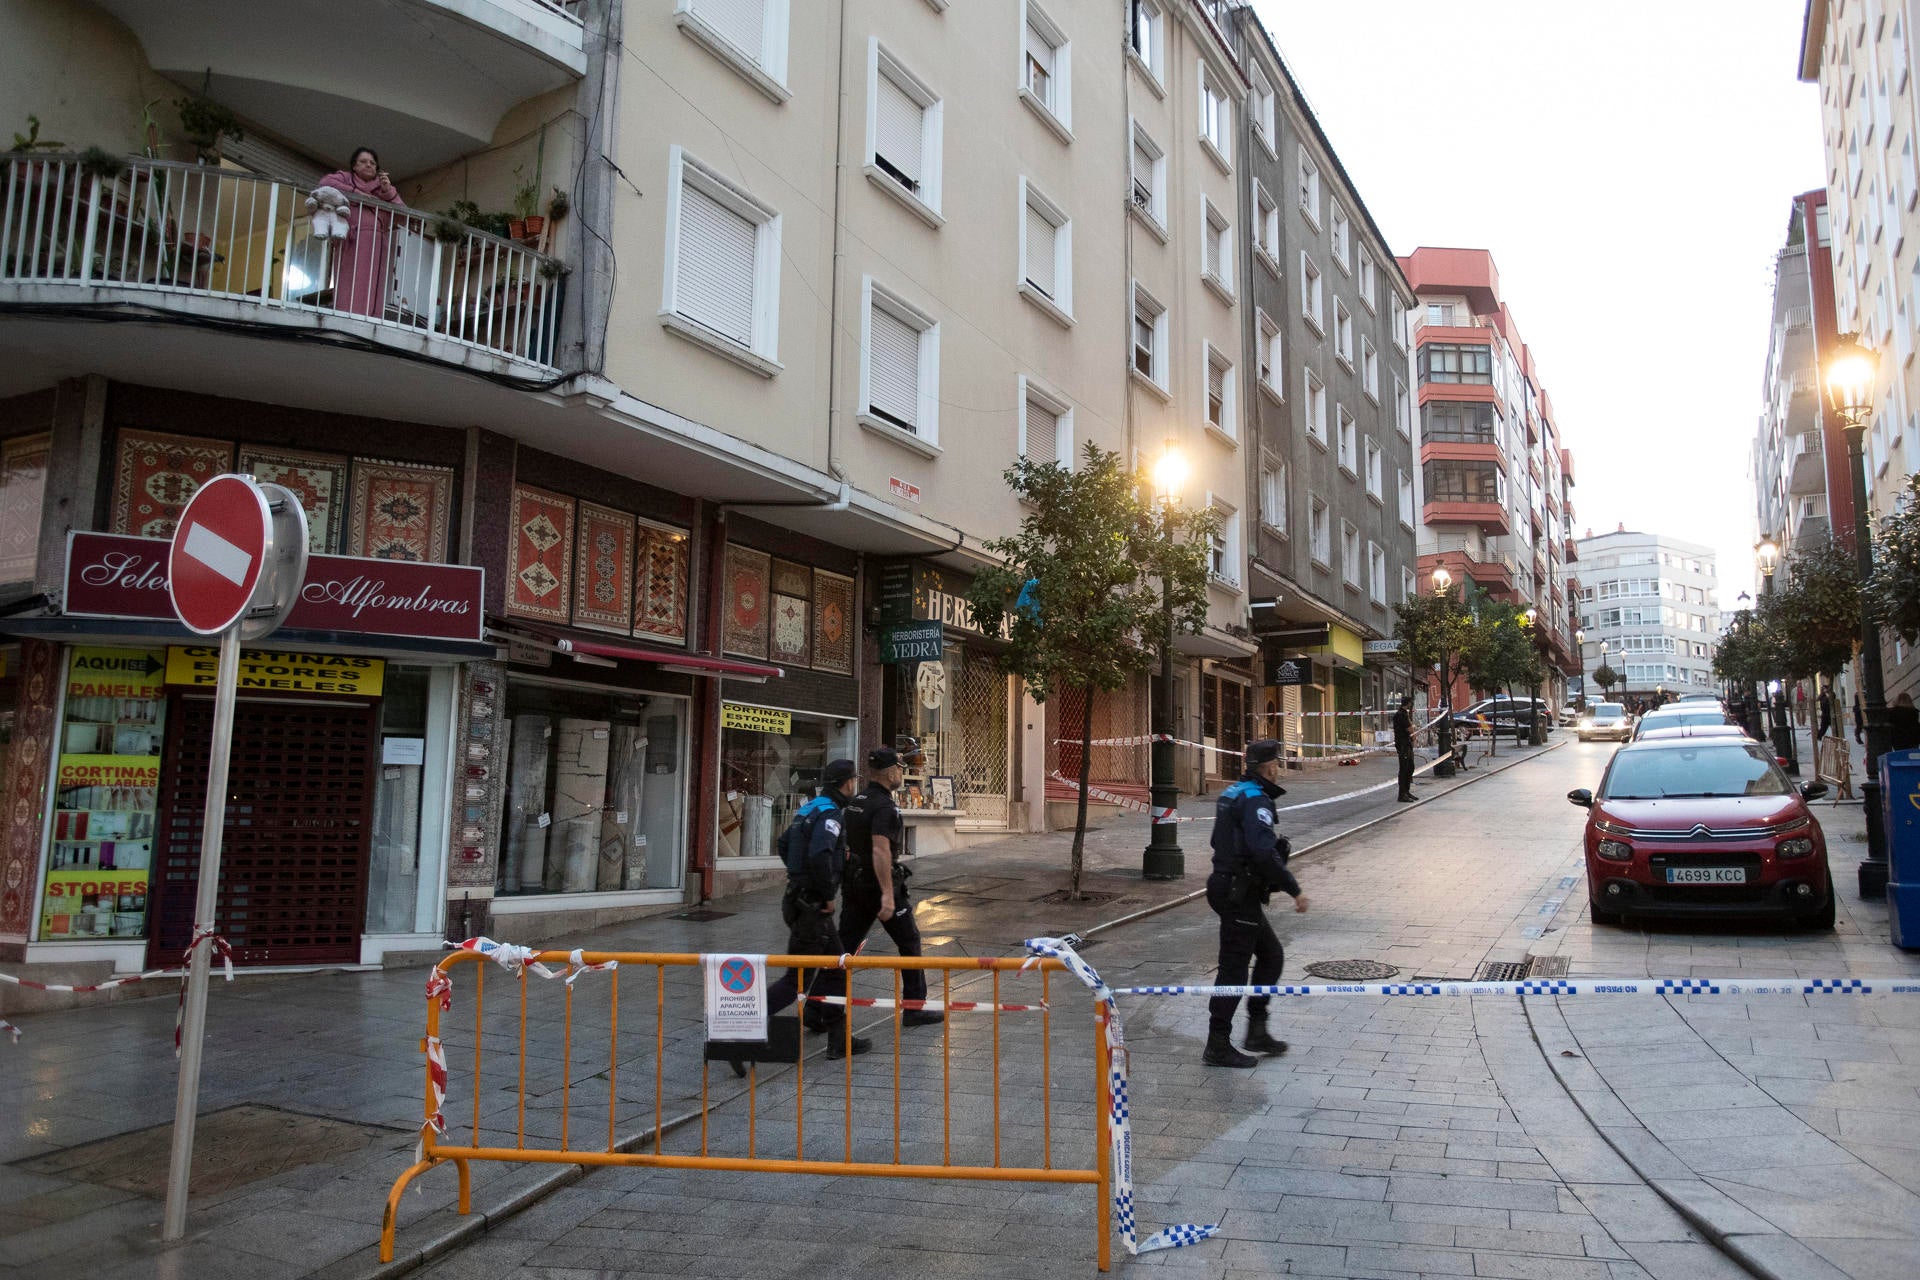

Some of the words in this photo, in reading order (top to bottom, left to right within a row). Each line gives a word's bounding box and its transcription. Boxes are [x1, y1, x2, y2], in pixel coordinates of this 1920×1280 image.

[301, 575, 470, 618] Alfombras
[892, 641, 939, 659] YEDRA
[75, 656, 127, 670] AQUI
[194, 661, 361, 680] ETORES
[71, 682, 164, 698] PANELES
[194, 675, 358, 693] PNELES
[723, 704, 789, 718] CORTINAS
[726, 713, 785, 726] ESTORES
[726, 721, 785, 733] PANELES
[62, 765, 158, 779] CORTINAS
[61, 778, 156, 788] ENROLLABLES
[1676, 870, 1711, 882] 4699
[1715, 870, 1742, 881] KCC
[49, 881, 148, 897] STORES
